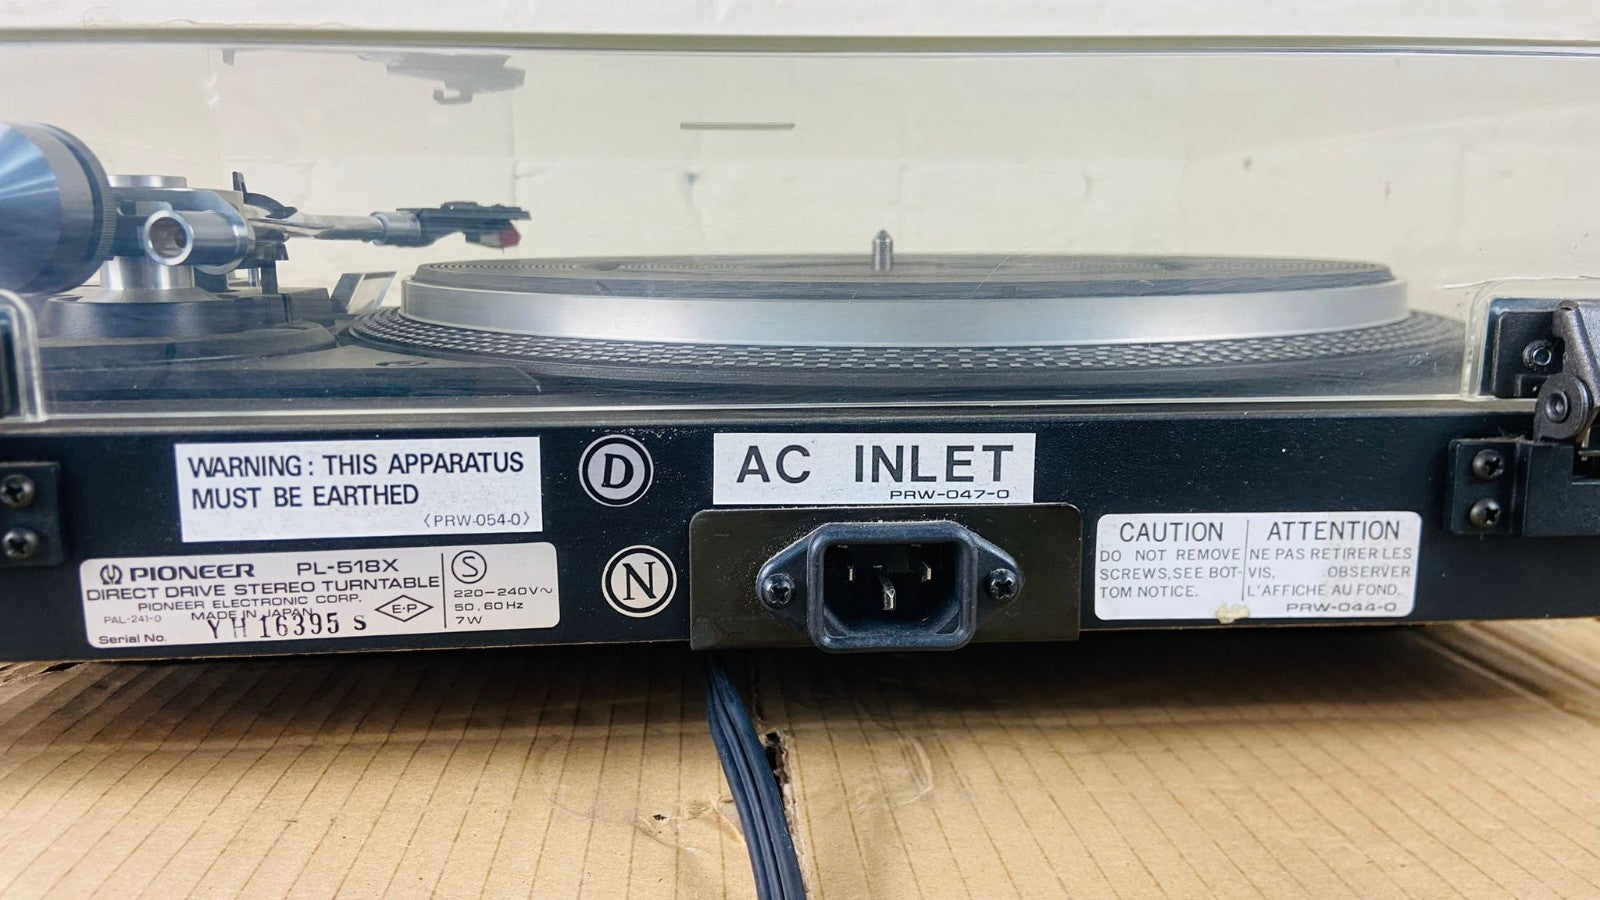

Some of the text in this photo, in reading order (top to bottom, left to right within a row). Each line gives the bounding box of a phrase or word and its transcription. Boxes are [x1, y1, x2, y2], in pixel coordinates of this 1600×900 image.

[322, 453, 377, 475] THIS
[388, 451, 524, 474] APPARATUS
[602, 453, 634, 489] D
[736, 444, 1014, 483] AC INLET
[192, 484, 419, 509] MUST BE EARTHED
[890, 489, 1010, 499] PRW-047-0
[1120, 522, 1223, 542] CAUTION
[1267, 520, 1400, 541] ATTENTION
[1100, 548, 1241, 562] DO NOT REMOVE
[1249, 547, 1412, 561] NE PAS RETIRER LES
[129, 563, 256, 582] PIONEER
[297, 559, 399, 576] PL-518X
[461, 556, 478, 577] S
[1209, 567, 1242, 580] BOT-
[1248, 566, 1411, 581] VIS, OBSERVER
[87, 576, 440, 601] DIRECT DRIVE STEREO TURNTABLE
[622, 562, 656, 601] N
[1099, 585, 1198, 598] TOM NOTICE.
[1247, 584, 1327, 597] L'AFFICHE
[1331, 584, 1351, 597] AU
[138, 594, 362, 612] PIONEER ELECTRONIC CORP.
[1286, 602, 1397, 613] PRW-044-0
[103, 615, 162, 624] PAL-241-0
[191, 608, 313, 621] MADE IN JAPAN
[99, 633, 168, 645] Serial No.
